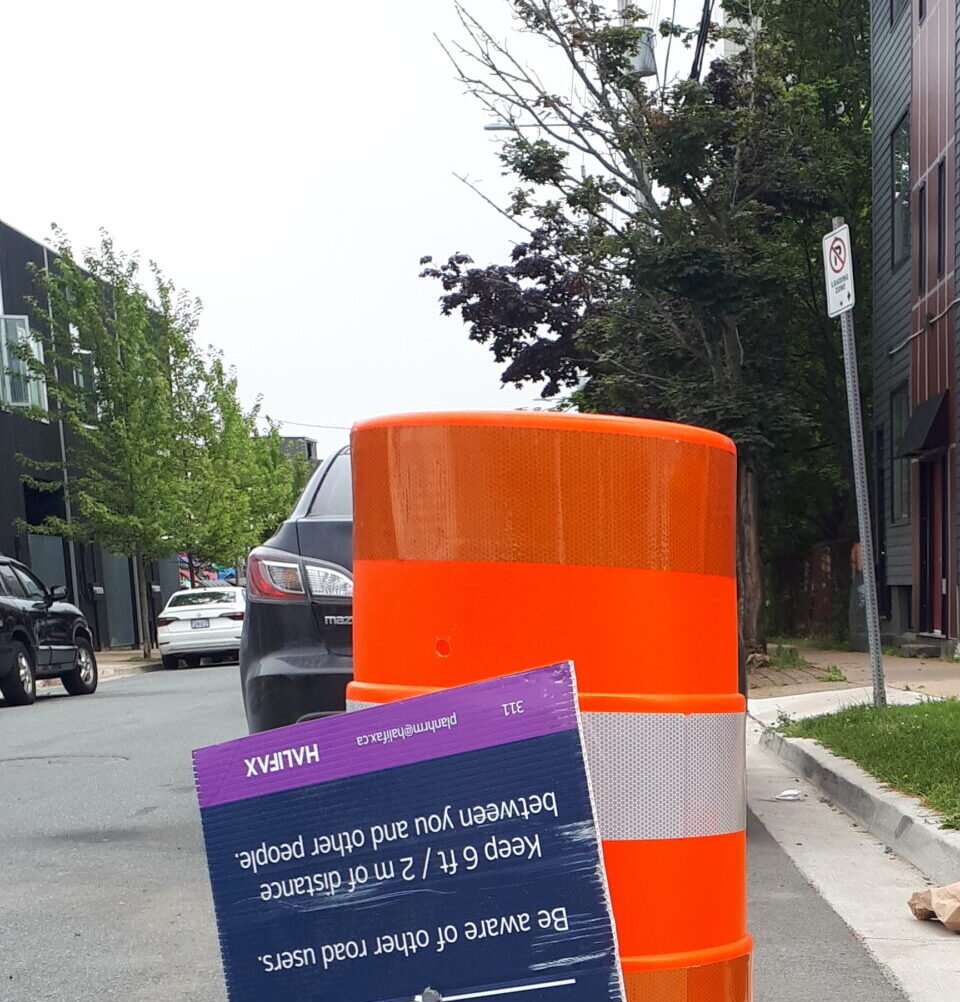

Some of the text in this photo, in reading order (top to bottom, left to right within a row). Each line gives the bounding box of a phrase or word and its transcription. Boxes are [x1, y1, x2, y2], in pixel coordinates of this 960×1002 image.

[356, 711, 458, 746] planhrm@halifax.ca
[501, 700, 525, 717] 311
[243, 743, 320, 778] HALIFAX
[234, 791, 559, 872] between you and other people.
[259, 833, 542, 901] Keep 6 ft / 2 m of distance
[257, 906, 569, 972] Be aware of other road users.
